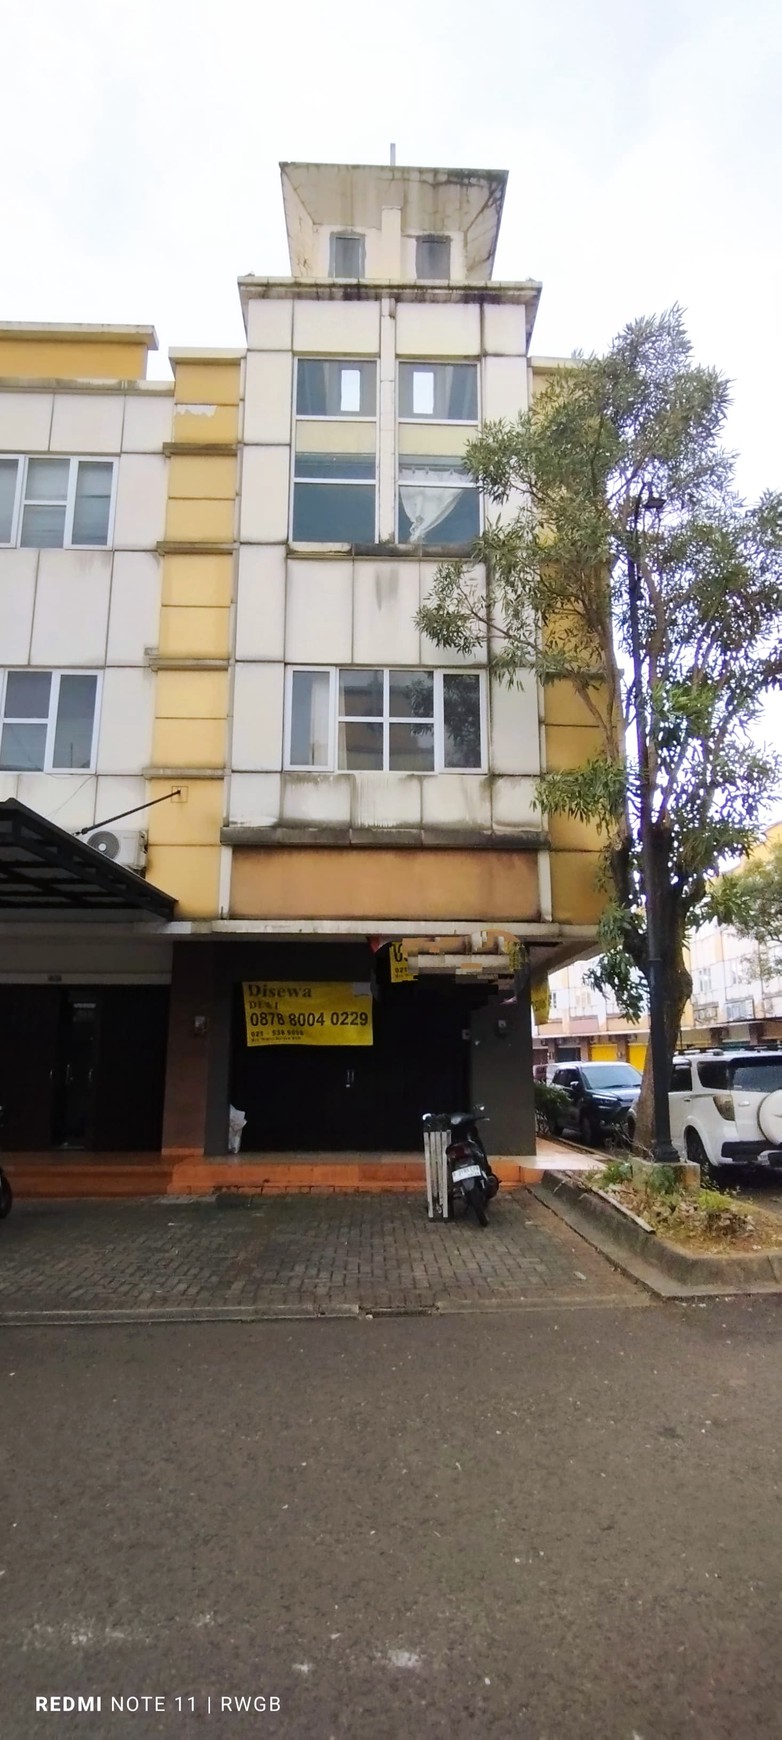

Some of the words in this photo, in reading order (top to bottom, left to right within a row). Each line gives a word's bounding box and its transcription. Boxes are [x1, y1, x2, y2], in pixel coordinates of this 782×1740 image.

[248, 984, 312, 998] Disewa
[250, 1012, 285, 1026] 0878
[289, 1012, 325, 1026] 8004
[331, 1012, 368, 1026] 0229
